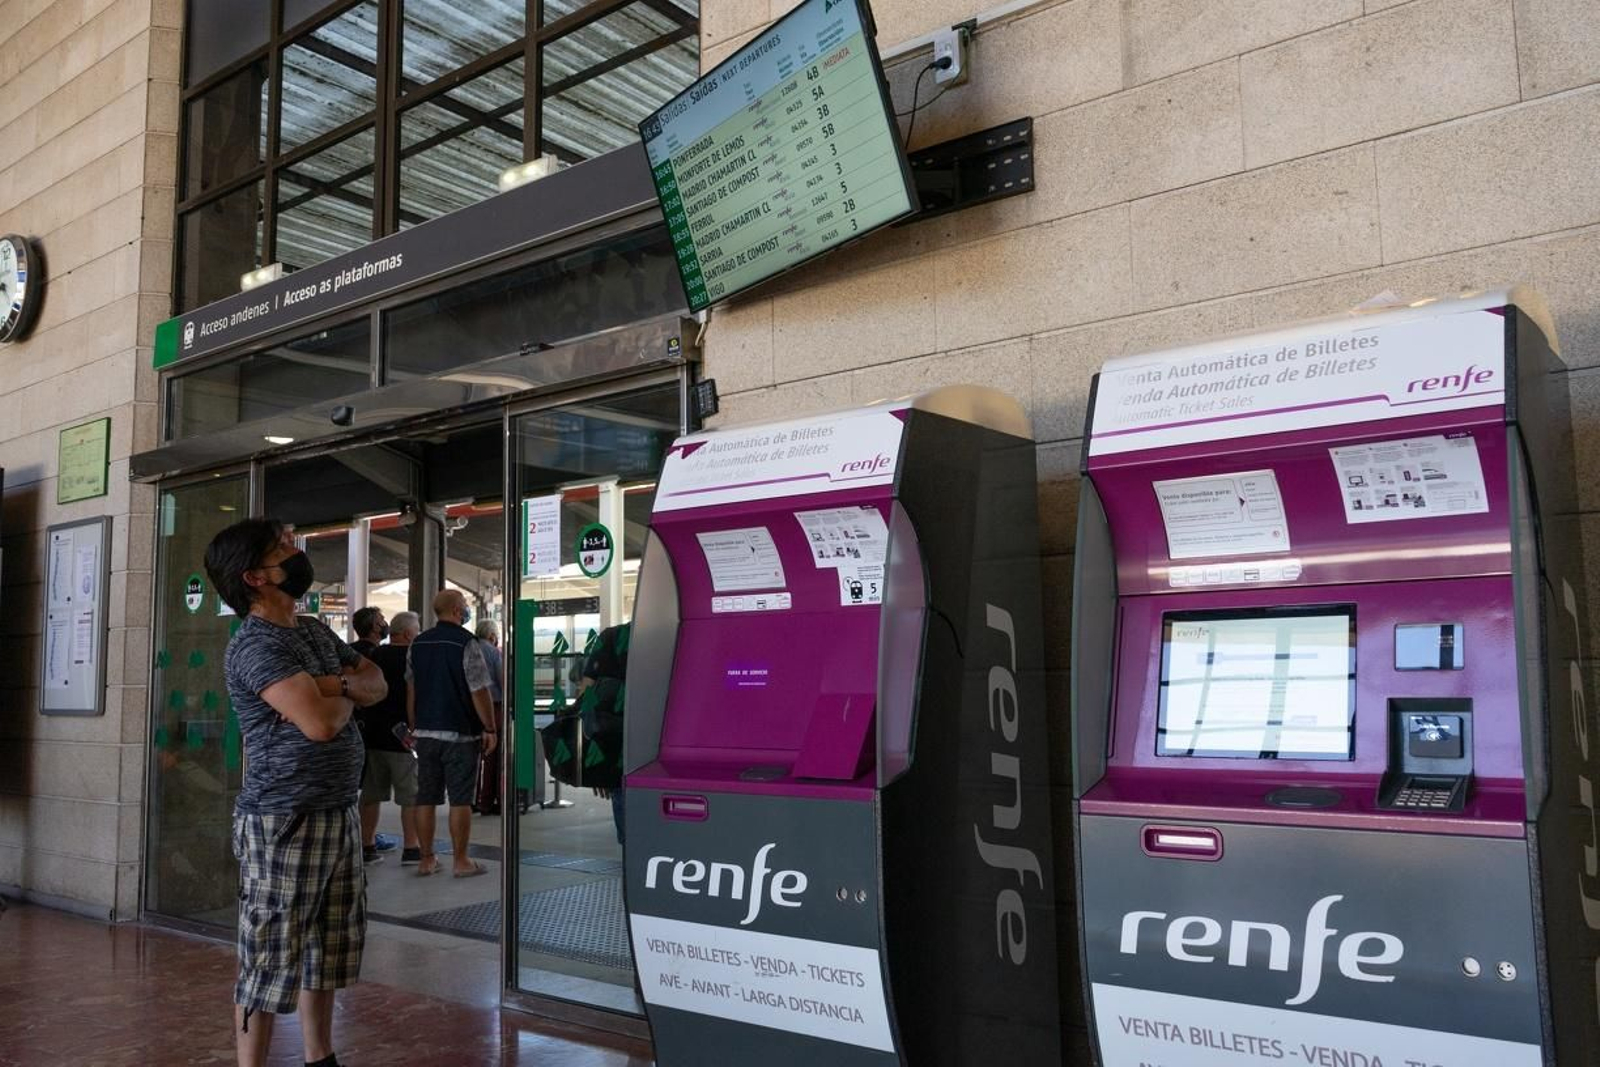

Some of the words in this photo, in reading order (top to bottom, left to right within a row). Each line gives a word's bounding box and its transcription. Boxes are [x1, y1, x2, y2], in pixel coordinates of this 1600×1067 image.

[659, 98, 686, 126] Salidas
[722, 65, 737, 81] NEXT
[739, 33, 781, 70] DEPARTURES
[672, 135, 714, 168] PONFERRADA
[806, 65, 819, 82] 4B
[677, 156, 711, 185] MONFORTE
[711, 150, 721, 164] DE
[721, 135, 744, 157] LEMOS
[811, 84, 824, 101] 5A
[681, 178, 707, 201] MADRID
[707, 154, 746, 186] CHAMARTIN
[747, 148, 756, 162] CL
[816, 103, 829, 119] 3B
[686, 192, 717, 217] SANTIAGO
[717, 186, 727, 198] DE
[727, 166, 760, 193] COMPOST
[822, 122, 834, 138] 5B
[690, 213, 714, 233] FERROL
[829, 143, 837, 156] 3
[695, 228, 721, 249] MADRID
[721, 206, 761, 235] CHAMARTIN
[761, 201, 771, 214] CL
[835, 161, 842, 174] 3
[699, 246, 723, 266] SARRIA
[840, 180, 847, 193] 5
[704, 258, 736, 281] SANTIAGO
[736, 253, 746, 265] DE
[746, 236, 779, 260] COMPOST
[843, 198, 855, 213] 2B
[708, 282, 725, 298] VIGO
[851, 218, 857, 230] 3
[200, 317, 228, 337] Acceso
[230, 300, 270, 327] andenes
[283, 284, 317, 307] Acceso
[319, 280, 332, 294] as
[334, 253, 403, 293] plataformas
[1119, 388, 1163, 406] enda
[1166, 372, 1270, 400] Automática
[1275, 367, 1300, 384] de
[1304, 356, 1377, 380] Billetes
[1167, 353, 1268, 379] Automática
[1275, 346, 1298, 362] de
[1304, 335, 1379, 358] Billetes
[1407, 364, 1494, 393] renfe
[773, 432, 787, 444] de
[790, 425, 834, 442] Billetes
[1178, 398, 1214, 417] Ticket
[1219, 394, 1254, 410] Sales
[770, 447, 784, 461] de
[786, 441, 831, 459] Billetes
[841, 453, 891, 474] renfe
[529, 522, 537, 534] 2
[529, 552, 537, 565] 2
[870, 582, 877, 595] 5
[974, 602, 1044, 967] renfe
[645, 842, 808, 925] renfe
[646, 937, 686, 956] VENTA
[687, 943, 742, 967] BILLETES
[750, 955, 798, 977] VENDA
[808, 964, 865, 988] TICKETS
[1119, 894, 1404, 1006] renfe
[659, 973, 681, 989] AVE
[691, 979, 731, 999] AVANT
[741, 987, 787, 1010] LARGA
[789, 997, 864, 1024] DISTANCIA
[1118, 1015, 1185, 1044] VENTA
[1189, 1026, 1284, 1059] BILLETES
